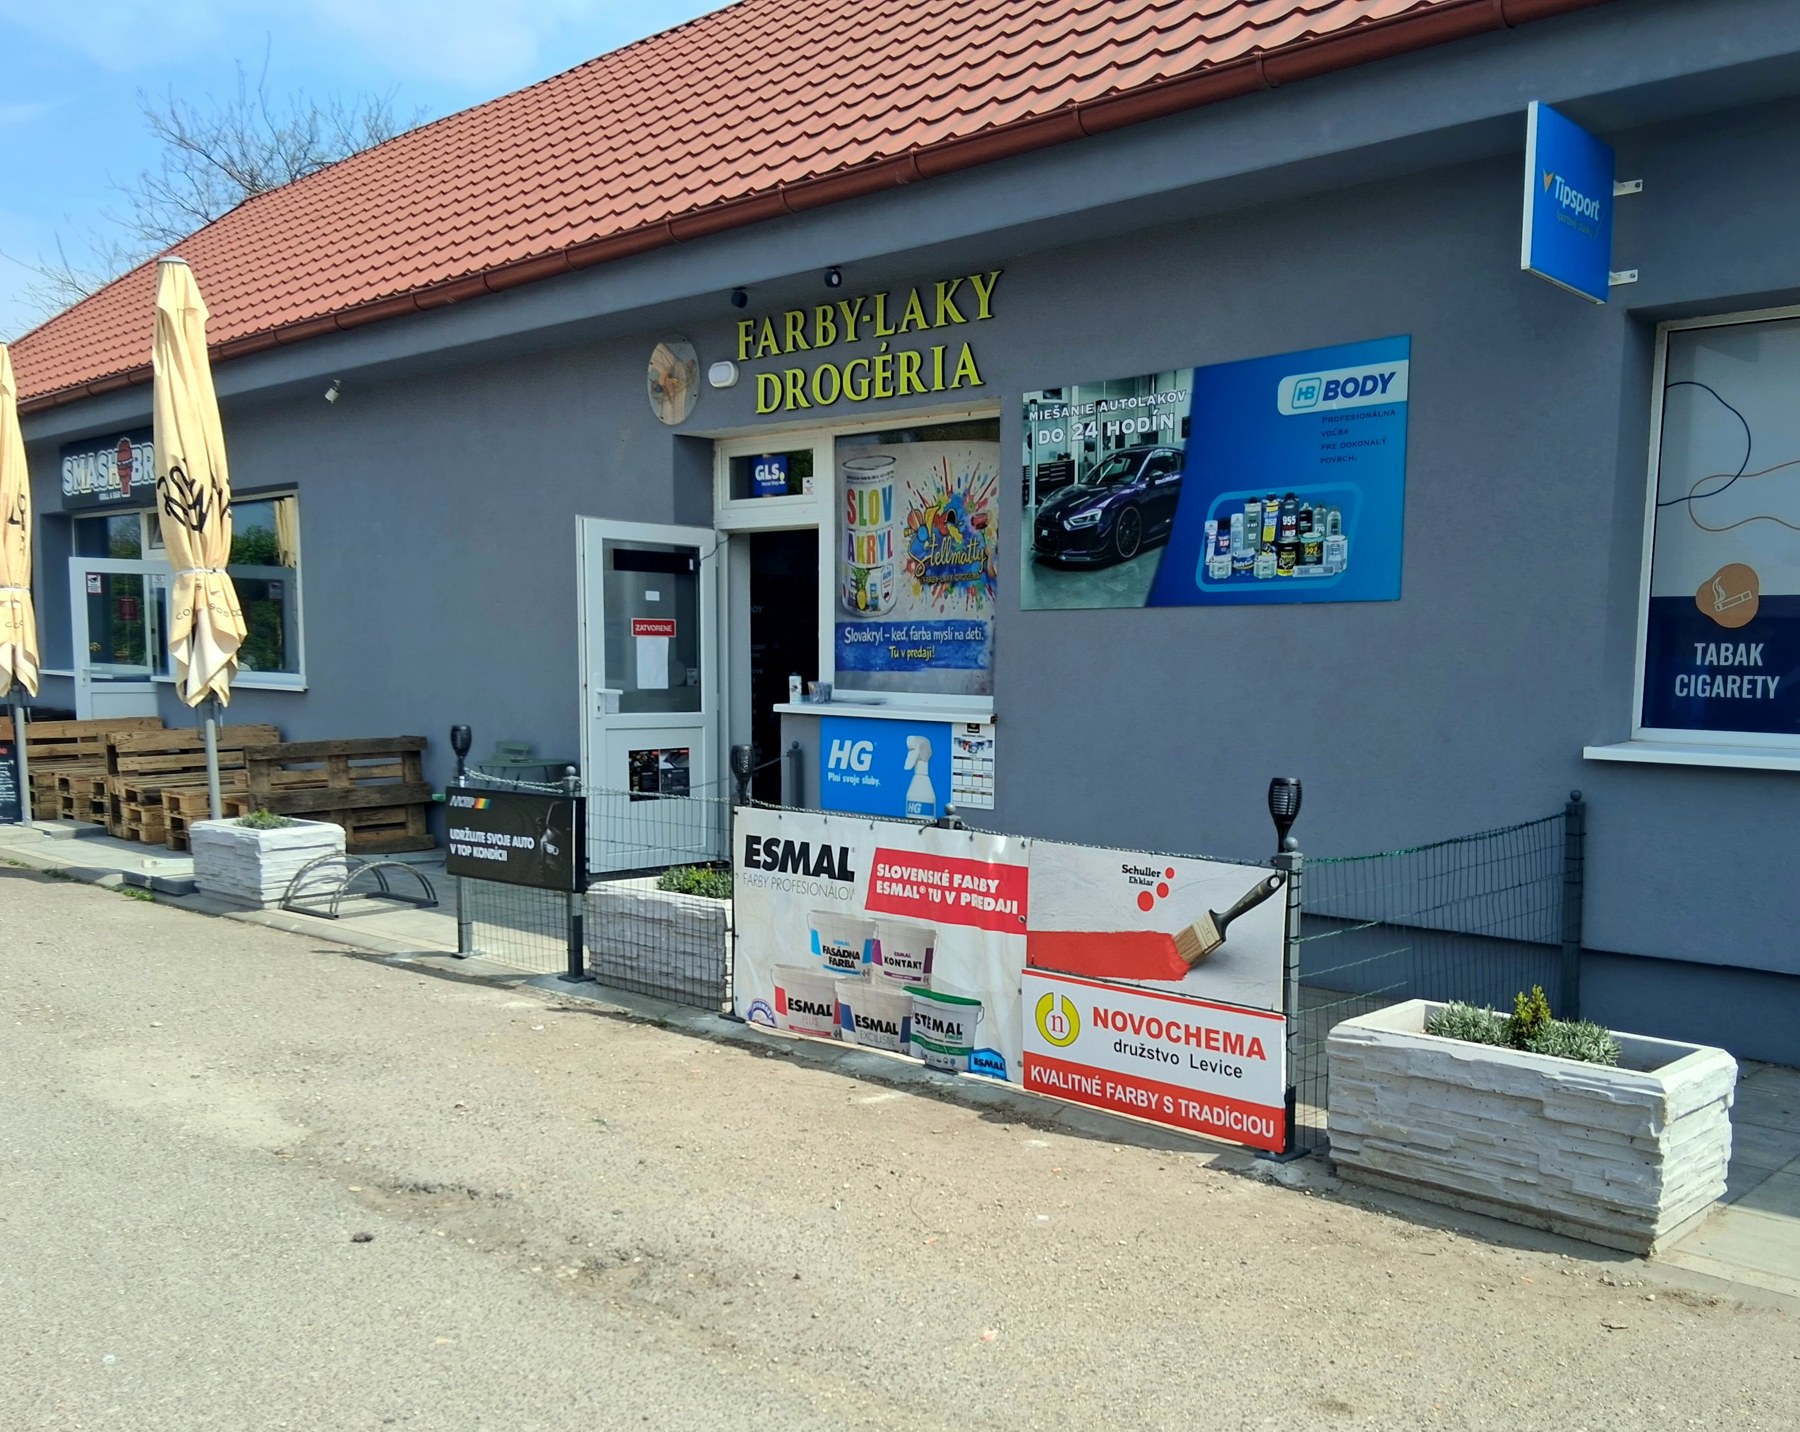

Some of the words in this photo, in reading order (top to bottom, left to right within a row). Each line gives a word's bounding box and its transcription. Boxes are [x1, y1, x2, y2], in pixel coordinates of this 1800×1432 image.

[1555, 175, 1600, 221] Tipsport
[755, 341, 985, 414] DROGÉRIA
[1296, 385, 1317, 401] HB
[1322, 371, 1397, 402] BODY
[1029, 403, 1095, 422] MIEŠANIE
[1099, 389, 1187, 413] AUTOLAKOV
[1038, 428, 1065, 445] DO
[1071, 420, 1098, 442] 24
[1106, 409, 1176, 437] HODÍN
[1321, 442, 1338, 450] PRE
[62, 447, 120, 497] SMASH
[755, 463, 780, 482] GLS
[847, 485, 893, 527] SLOV
[1282, 515, 1297, 526] 955
[847, 528, 893, 565] AKRYL
[909, 533, 987, 577] Stellmatty
[844, 627, 884, 645] Slovakryl
[909, 626, 932, 641] farba
[933, 627, 953, 643] myslí
[954, 630, 964, 640] na
[965, 627, 984, 641] deti.
[889, 646, 899, 658] Tu
[901, 649, 906, 658] v
[907, 645, 936, 661] predaji!
[1694, 643, 1764, 666] TABAK
[1674, 674, 1780, 699] CIGARETY
[828, 739, 874, 772] HG
[907, 802, 922, 814] HG
[449, 843, 457, 855] V
[457, 844, 472, 857] TOP
[486, 832, 512, 847] SVOJE
[511, 836, 535, 850] AUTO
[744, 834, 856, 883] ESMAL
[1121, 864, 1162, 878] Schuller
[742, 872, 770, 889] FARBY
[771, 876, 855, 901] PROFESIONÁLOV
[876, 863, 950, 887] SLOVENSKÉ
[953, 874, 1000, 894] FARBY
[928, 888, 942, 903] TU
[944, 891, 956, 905] V
[960, 893, 1019, 915] PREDAJI
[822, 945, 861, 961] FASÁDNA
[828, 956, 856, 970] FARBA
[884, 956, 923, 970] KONTAKT
[787, 997, 833, 1018] ESMAL
[855, 1014, 899, 1036] ESMAL
[914, 1012, 964, 1036] STEMAL
[1092, 1006, 1267, 1061] NOVOCHEMA
[973, 1056, 1005, 1072] ESMAL
[1113, 1038, 1180, 1065] družstvo
[1189, 1053, 1243, 1079] Levice
[1030, 1064, 1102, 1097] KVALITNÉ
[1106, 1083, 1159, 1110] FARBY
[1162, 1095, 1174, 1114] S
[1178, 1097, 1275, 1139] TRADÍCIOU
